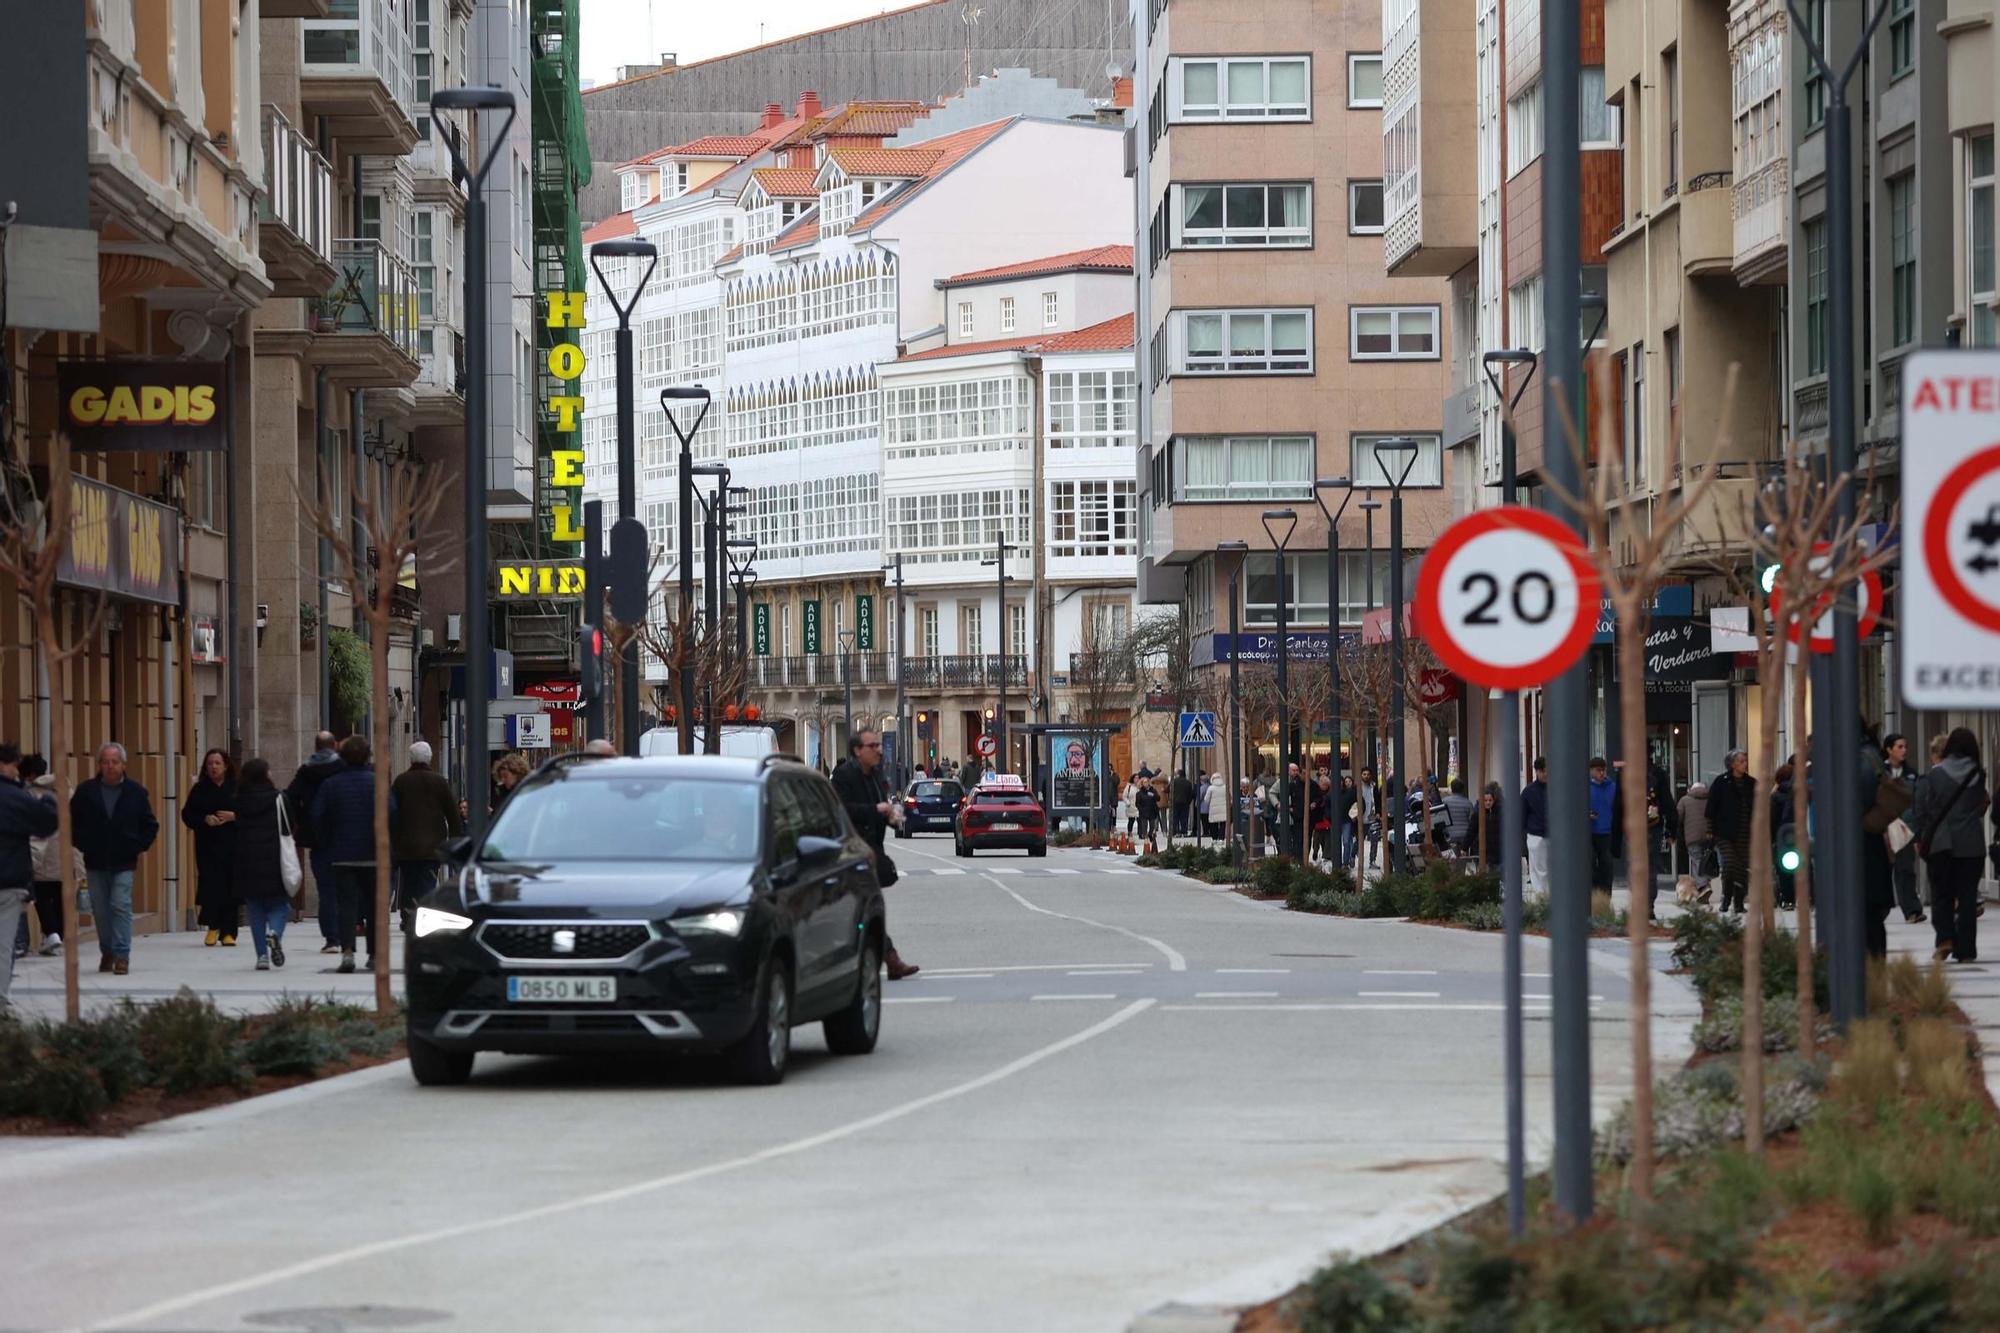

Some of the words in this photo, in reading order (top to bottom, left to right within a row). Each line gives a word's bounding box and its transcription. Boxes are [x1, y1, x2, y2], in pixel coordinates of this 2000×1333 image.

[69, 384, 216, 425] GADIS
[1912, 376, 2000, 412] ATE
[546, 292, 586, 541] HOTEL
[1460, 571, 1555, 625] 20
[758, 606, 766, 652] ADAMS
[807, 604, 815, 650] ADAMS
[861, 598, 869, 646] ADAMS
[1645, 626, 1678, 647] utas
[1683, 624, 1693, 641] y
[1649, 645, 1713, 673] Verdura
[1915, 663, 2000, 690] EXCE
[1056, 767, 1098, 778] ANTROID
[520, 981, 567, 998] 0850
[574, 981, 610, 998] MLB
